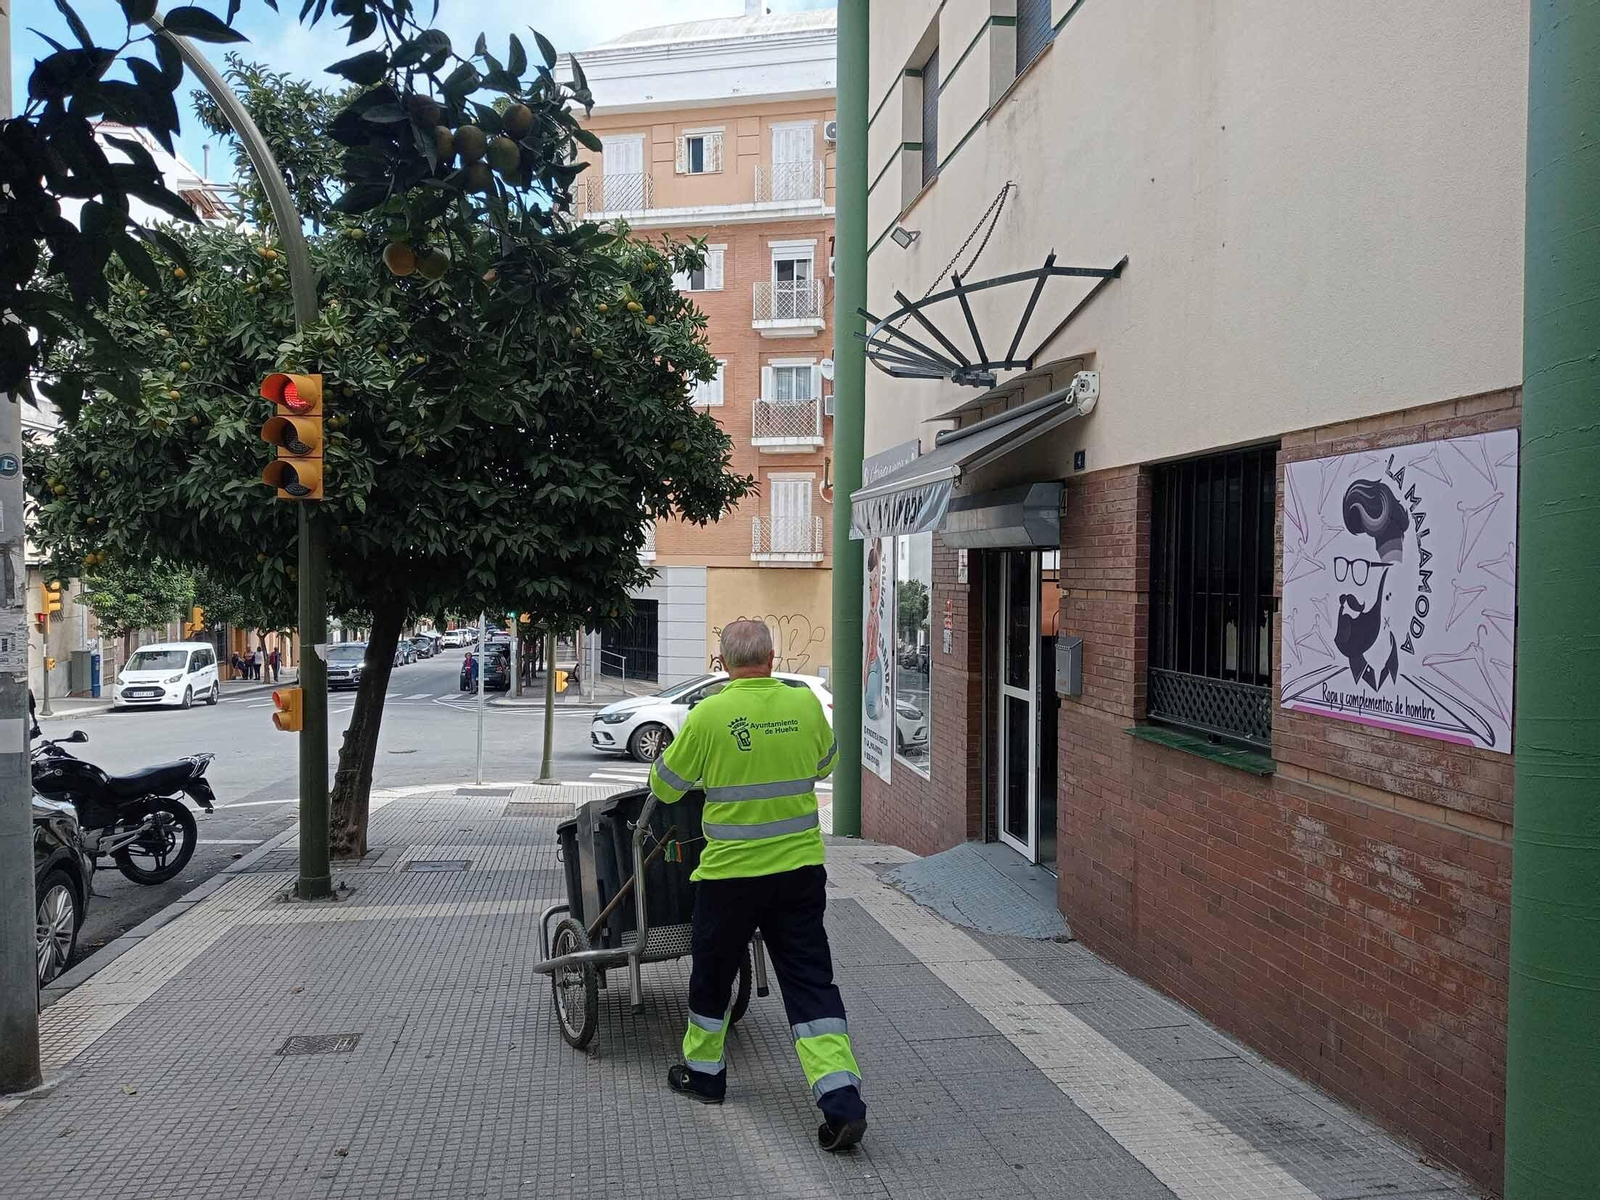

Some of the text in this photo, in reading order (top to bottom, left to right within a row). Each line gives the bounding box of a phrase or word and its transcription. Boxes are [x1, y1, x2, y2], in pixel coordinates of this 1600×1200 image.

[1060, 490, 1067, 514] 4
[1385, 453, 1434, 655] LA MALAMODA
[1322, 682, 1436, 721] Ropa y complementos de hombre
[750, 719, 798, 729] Ayuntamiento
[775, 726, 798, 734] Huelva
